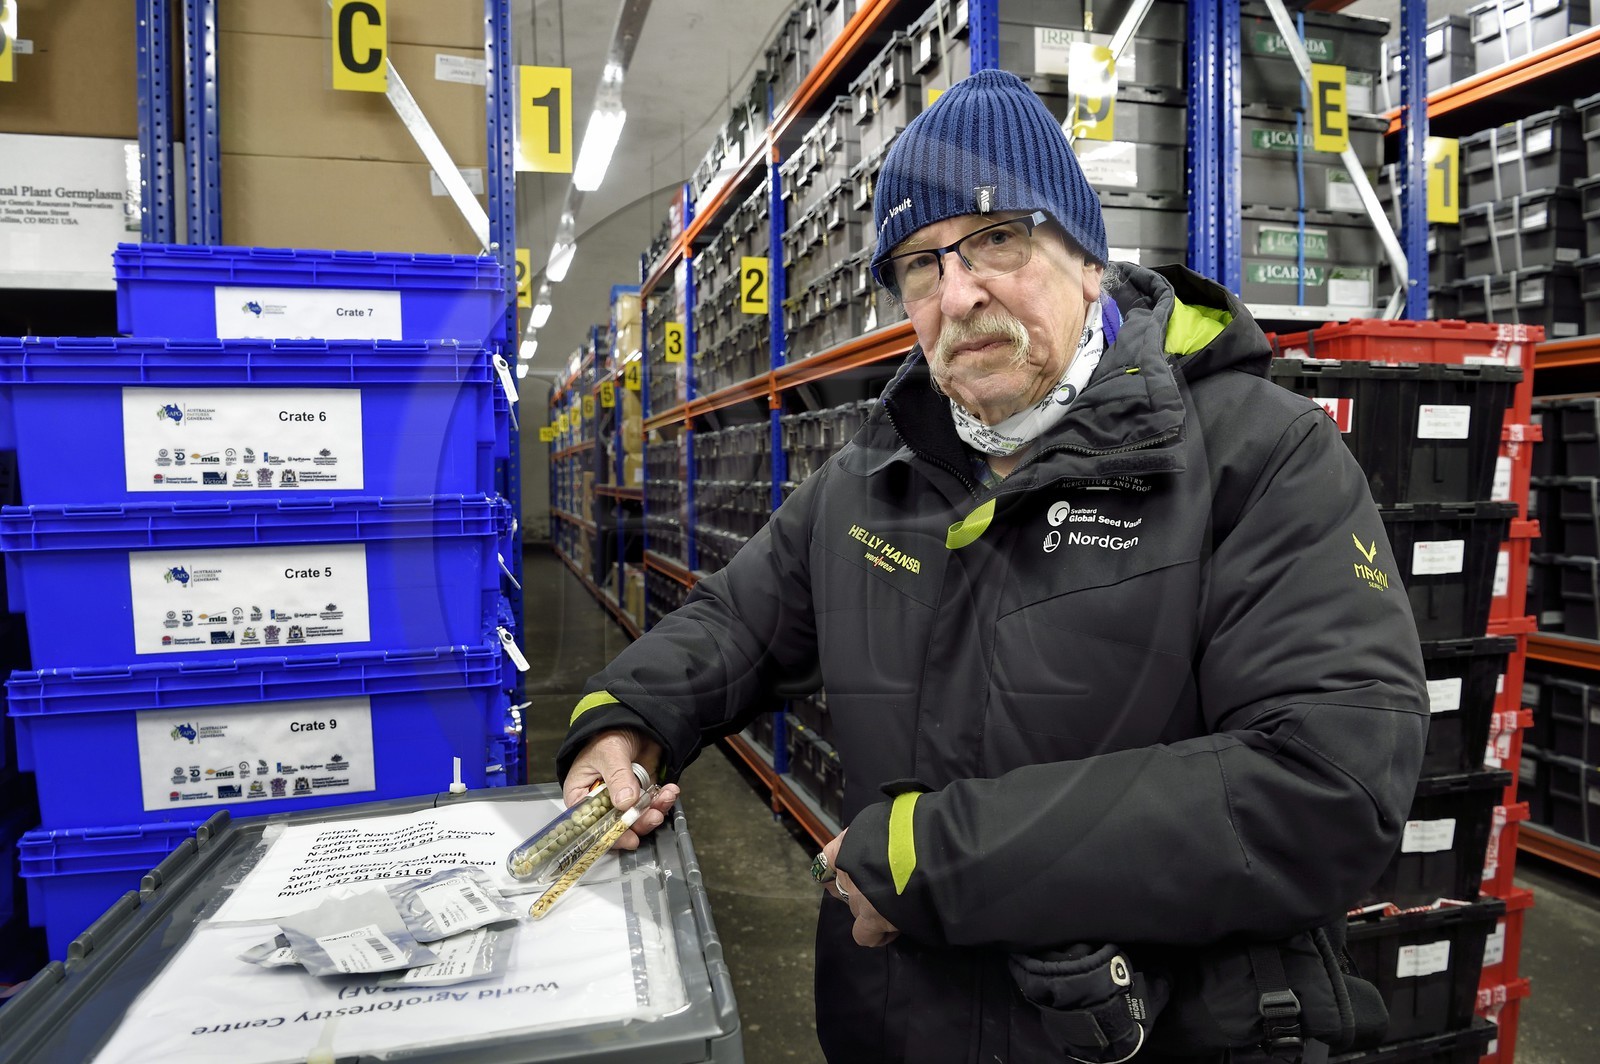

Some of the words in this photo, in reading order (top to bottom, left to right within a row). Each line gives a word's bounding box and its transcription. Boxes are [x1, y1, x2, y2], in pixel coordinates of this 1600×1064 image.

[338, 1, 382, 74] C
[1318, 81, 1343, 137] E
[532, 87, 561, 154] 1
[1434, 154, 1452, 207] 1
[21, 186, 52, 198] Plant
[55, 187, 123, 202] Germplasm
[889, 197, 913, 218] Vault
[745, 268, 765, 304] 2
[336, 307, 365, 317] Crate
[367, 308, 374, 317] 7
[668, 330, 682, 355] 3
[627, 366, 638, 385] 4
[603, 384, 612, 403] 5
[278, 410, 315, 422] Crate
[318, 410, 327, 422] 6
[201, 455, 220, 463] mla
[1113, 480, 1131, 489] AND
[1068, 514, 1097, 523] Global
[1098, 515, 1122, 528] Seed
[1123, 517, 1143, 529] Vault
[847, 524, 885, 551] HELLY
[1068, 531, 1140, 551] NordGen
[284, 567, 321, 579] Crate
[324, 566, 332, 578] 5
[290, 719, 326, 733] Crate
[329, 718, 337, 729] 9
[215, 770, 234, 778] mla
[311, 837, 390, 851] Gardermoen
[393, 826, 435, 841] airport
[364, 826, 414, 838] Nansens
[307, 846, 352, 857] N-2061
[356, 831, 434, 850] Gardermoen
[447, 829, 496, 837] Norway
[287, 865, 346, 883] Svalbard
[432, 851, 468, 859] Vault
[303, 850, 371, 864] Telephone
[325, 866, 386, 880] NordGen
[400, 858, 456, 869] Asmund
[459, 859, 497, 867] Asdal
[277, 885, 322, 898] Phone
[323, 876, 350, 889] +47
[354, 874, 369, 882] 91
[374, 871, 391, 879] 36
[395, 869, 411, 878] 51
[415, 867, 432, 876] 66
[477, 981, 560, 1000] World
[294, 991, 469, 1023] Agroforestry
[1131, 998, 1141, 1020] MICRO
[191, 1016, 286, 1036] Centre
